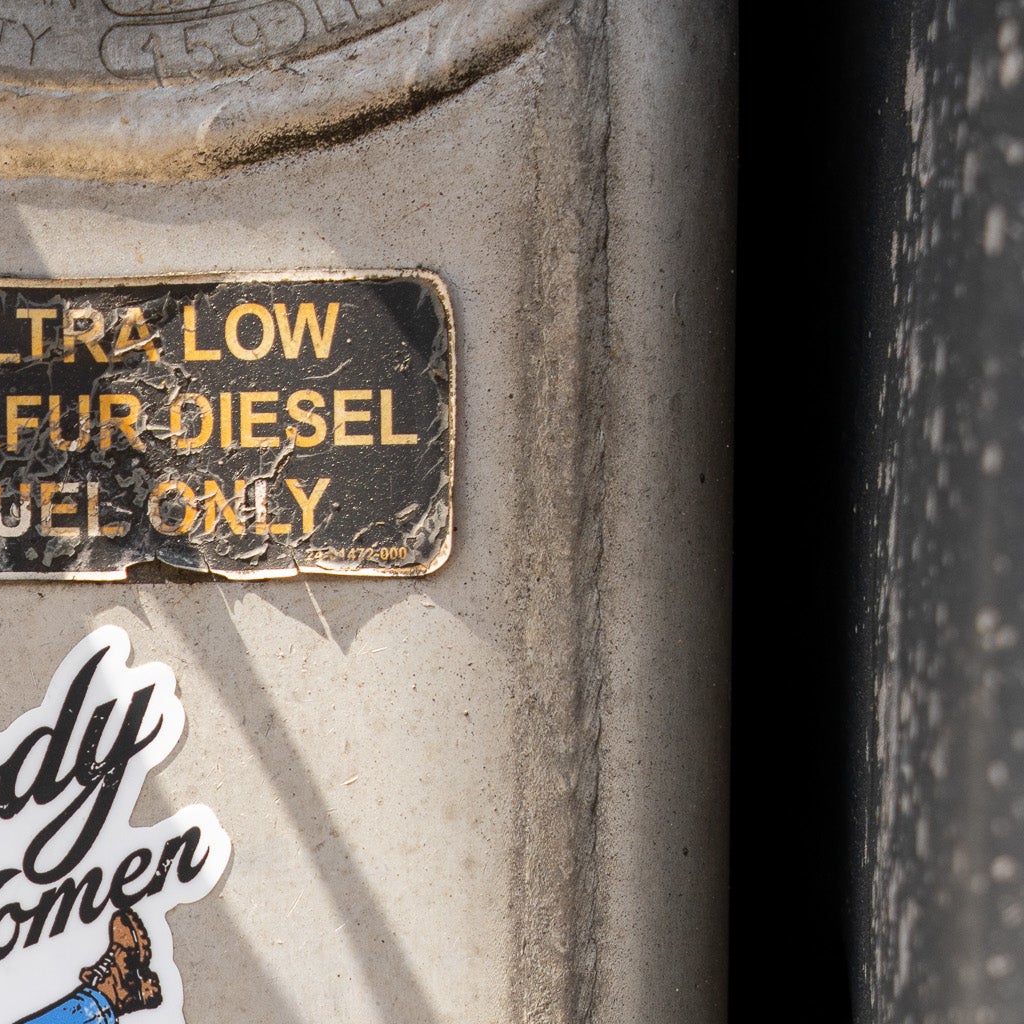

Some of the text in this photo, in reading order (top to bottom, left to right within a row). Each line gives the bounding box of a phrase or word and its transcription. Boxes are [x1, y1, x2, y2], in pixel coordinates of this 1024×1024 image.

[183, 302, 341, 362] LOW
[171, 389, 418, 451] DIESEL
[150, 478, 330, 537] ONLY
